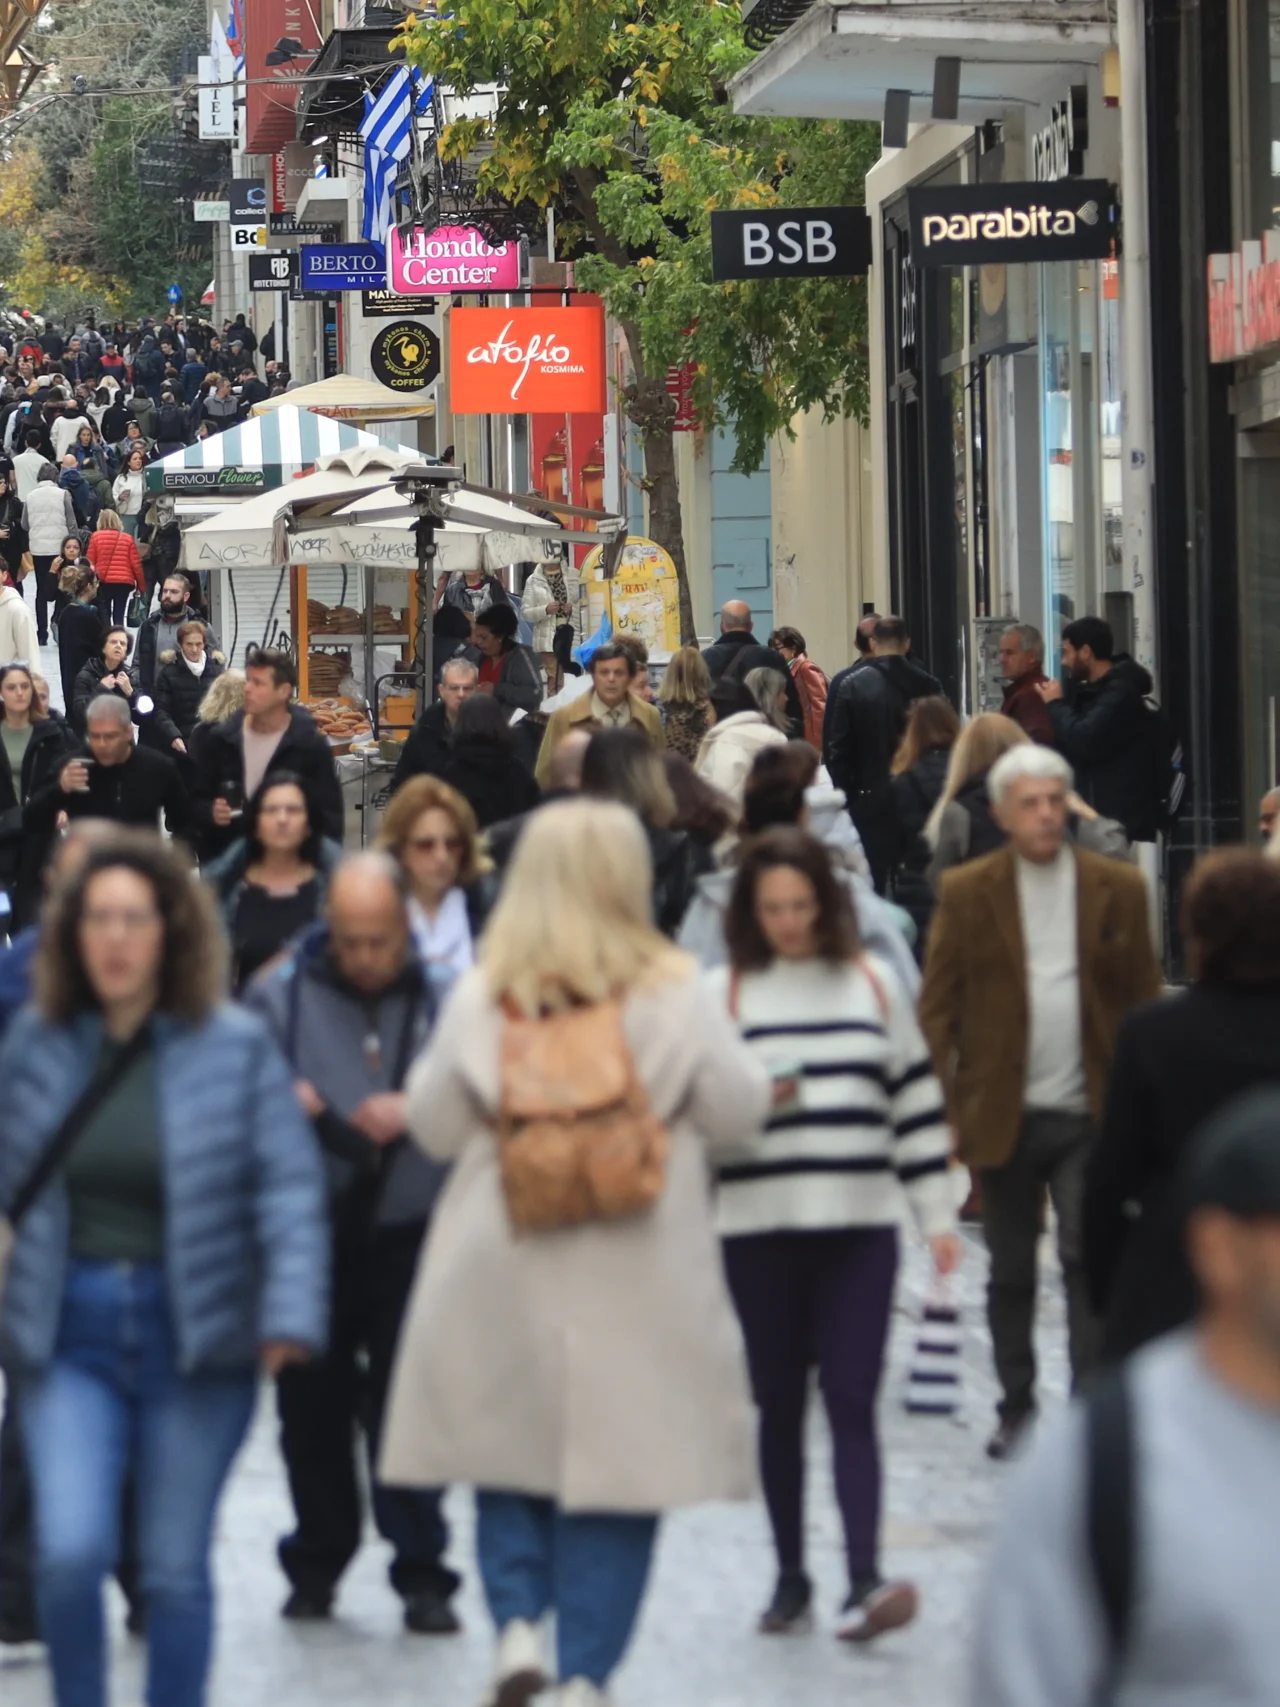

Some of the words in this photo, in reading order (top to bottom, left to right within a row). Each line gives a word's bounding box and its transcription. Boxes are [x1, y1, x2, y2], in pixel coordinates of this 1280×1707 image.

[923, 204, 1075, 247] parabita
[742, 220, 836, 266] BSB
[309, 255, 377, 271] BERTO
[402, 259, 498, 286] Center
[540, 365, 585, 374] KOSMIMA
[390, 378, 425, 387] COFFEE
[165, 473, 217, 486] ERMOU
[216, 467, 263, 485] Flower
